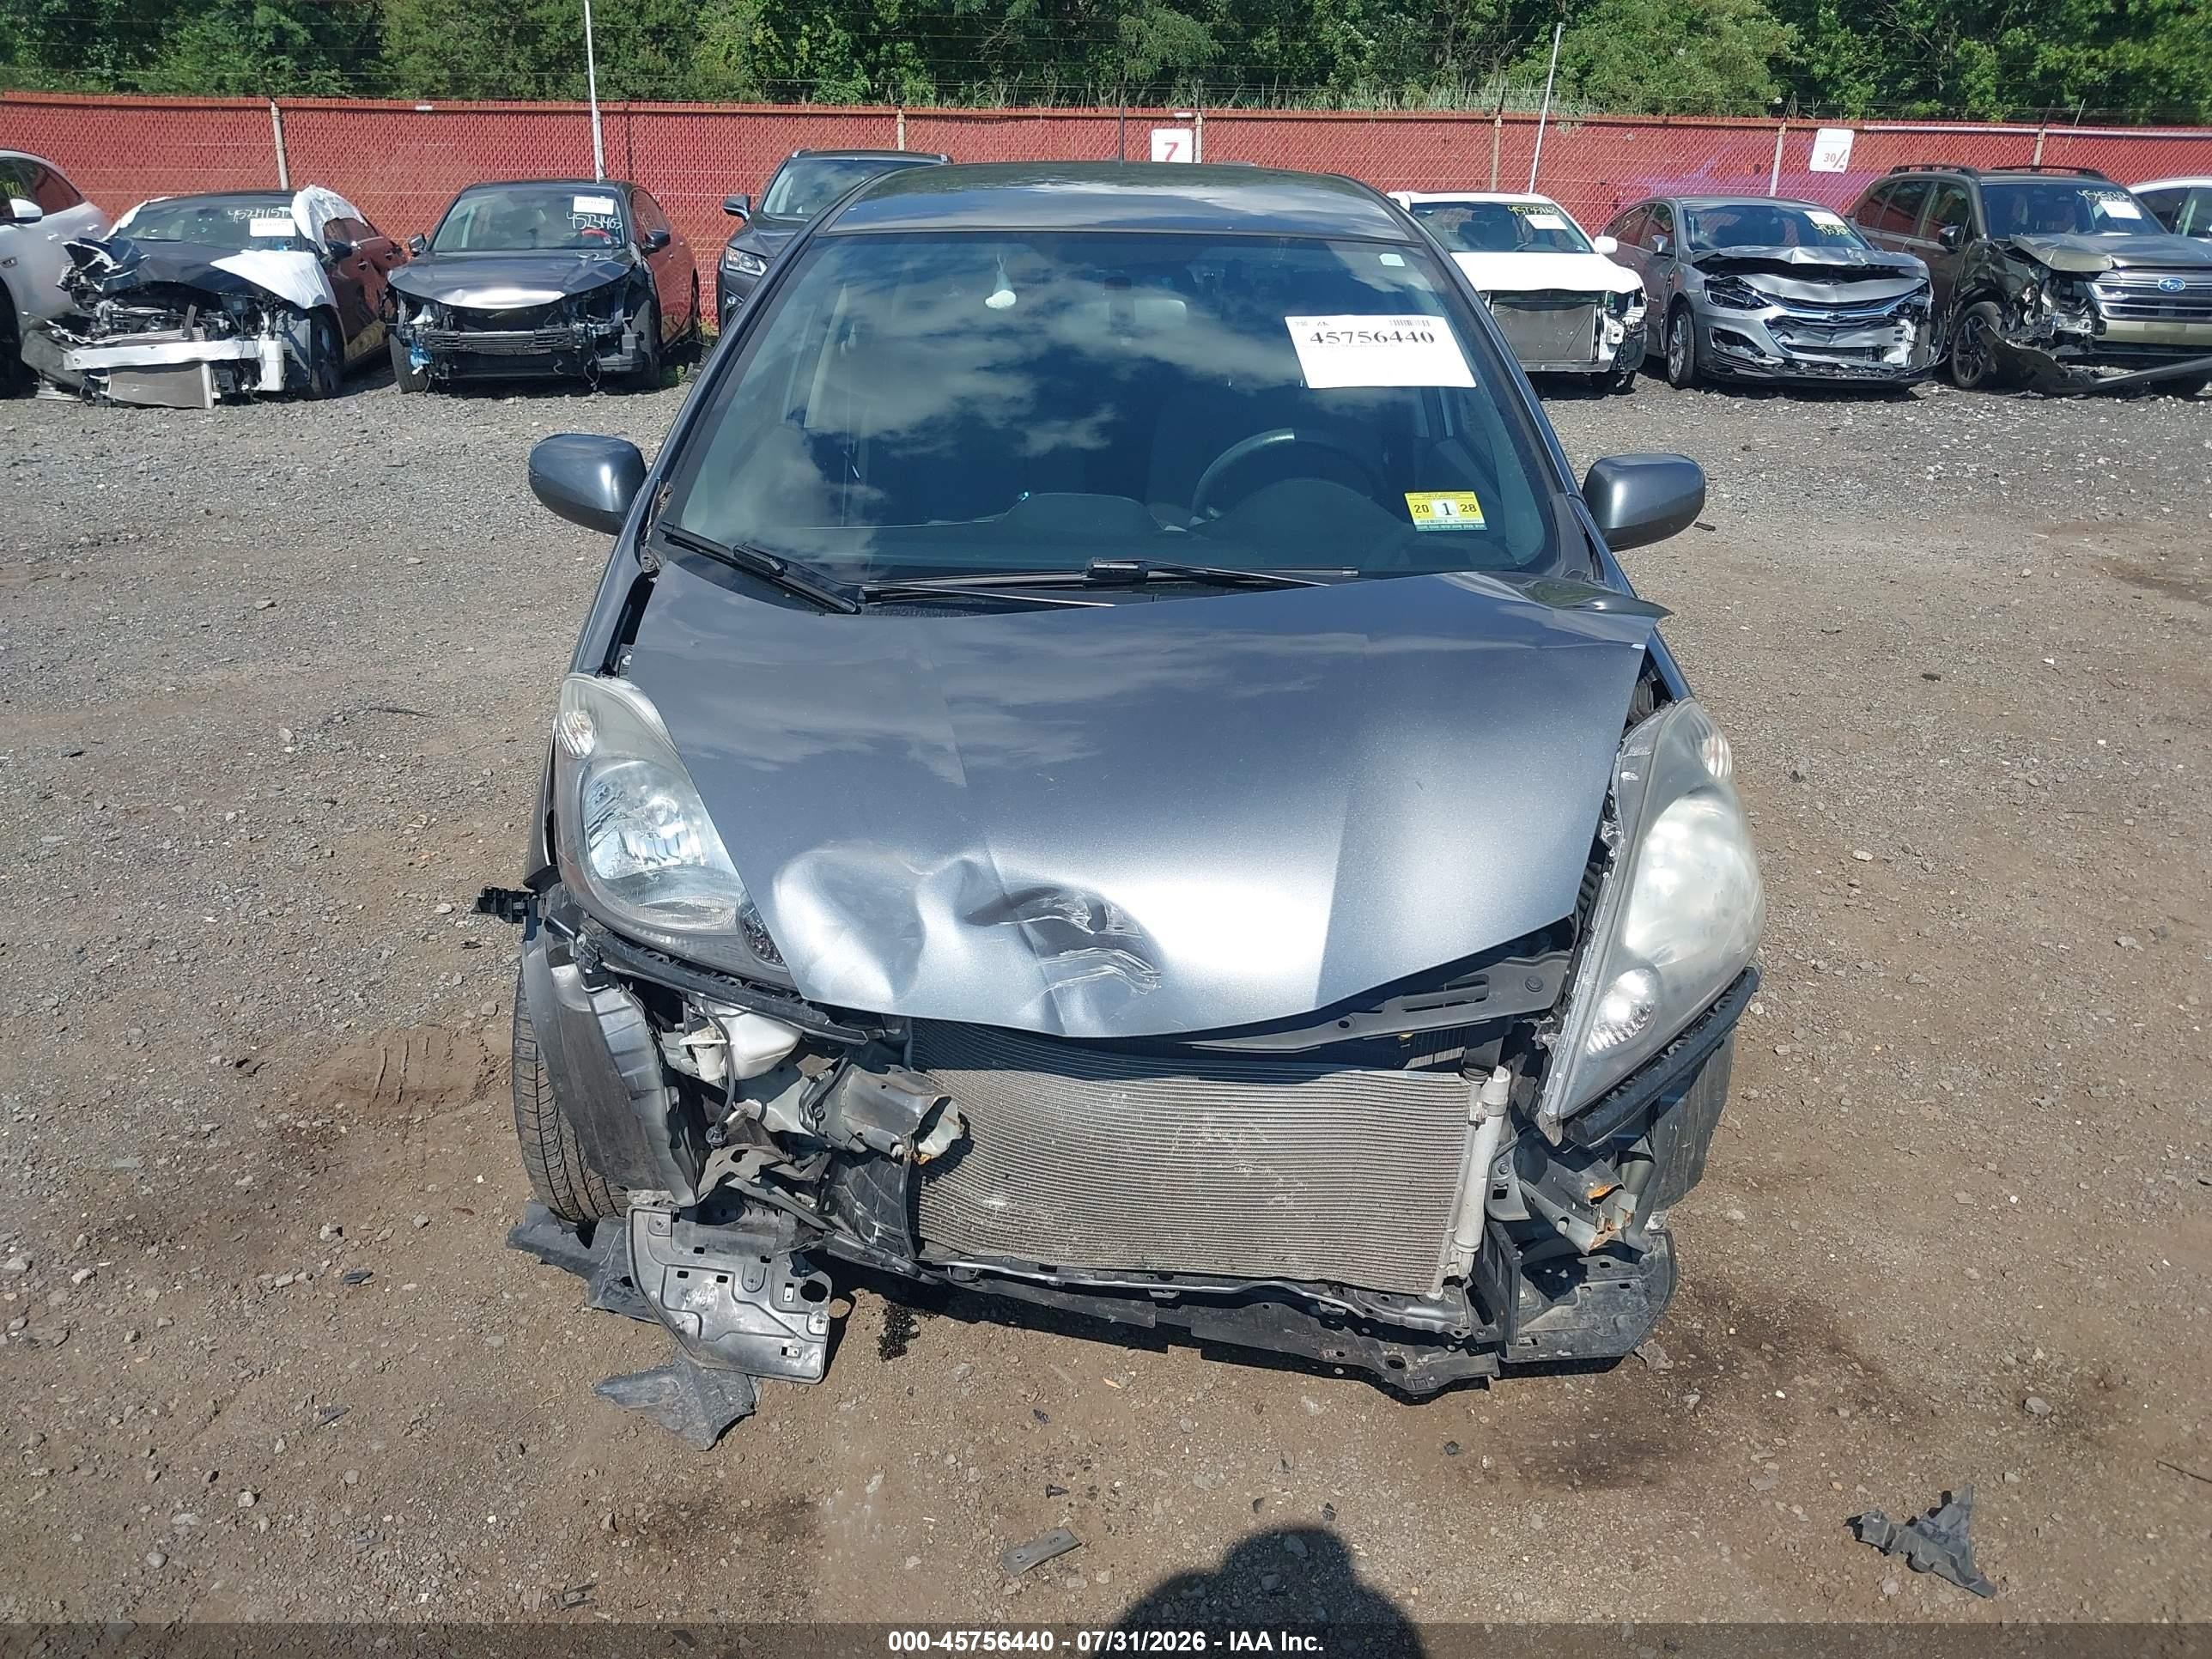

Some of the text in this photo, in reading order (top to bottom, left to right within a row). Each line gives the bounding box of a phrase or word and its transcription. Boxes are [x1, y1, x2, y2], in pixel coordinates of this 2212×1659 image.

[1164, 142, 1180, 162] 7
[1310, 330, 1436, 344] 45756440
[1413, 502, 1477, 516] 20 1 28
